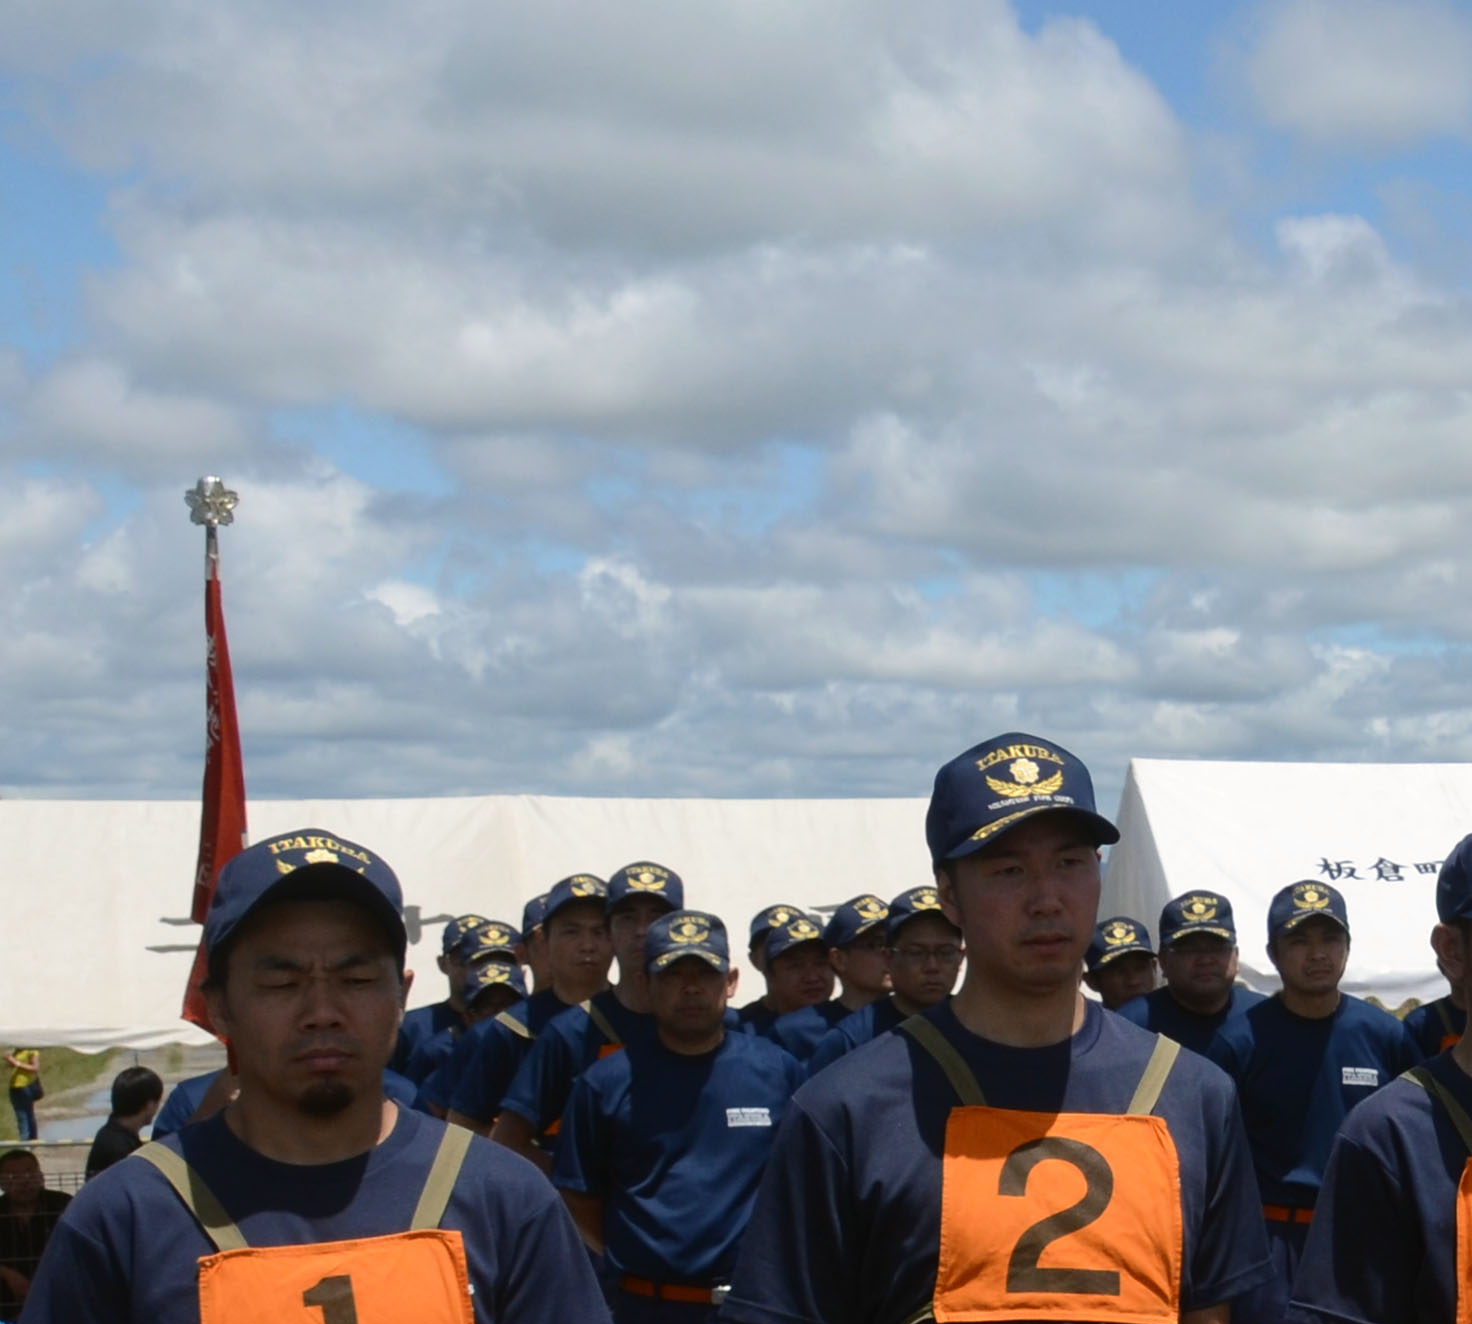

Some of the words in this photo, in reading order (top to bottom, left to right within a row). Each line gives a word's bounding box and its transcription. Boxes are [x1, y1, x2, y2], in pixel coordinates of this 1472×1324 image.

[975, 744, 1065, 771] ITAKURA
[269, 836, 372, 865] ITAKURA
[998, 1136, 1120, 1296] 2
